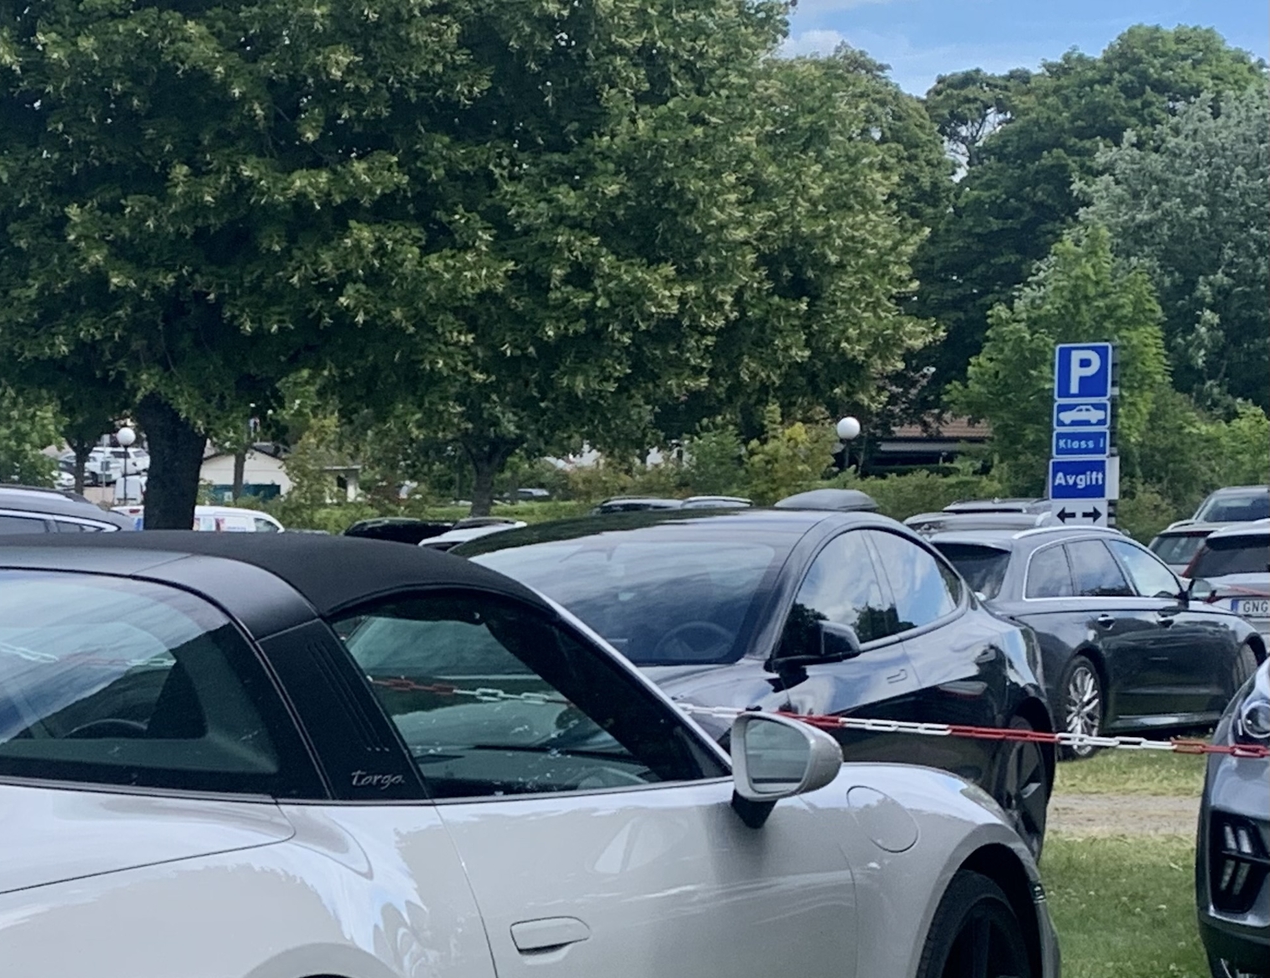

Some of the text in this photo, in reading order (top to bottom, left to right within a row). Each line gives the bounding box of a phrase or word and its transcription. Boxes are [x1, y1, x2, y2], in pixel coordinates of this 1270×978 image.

[1069, 350, 1101, 394] P
[1058, 438, 1094, 449] Klass
[1054, 470, 1104, 490] Avgift
